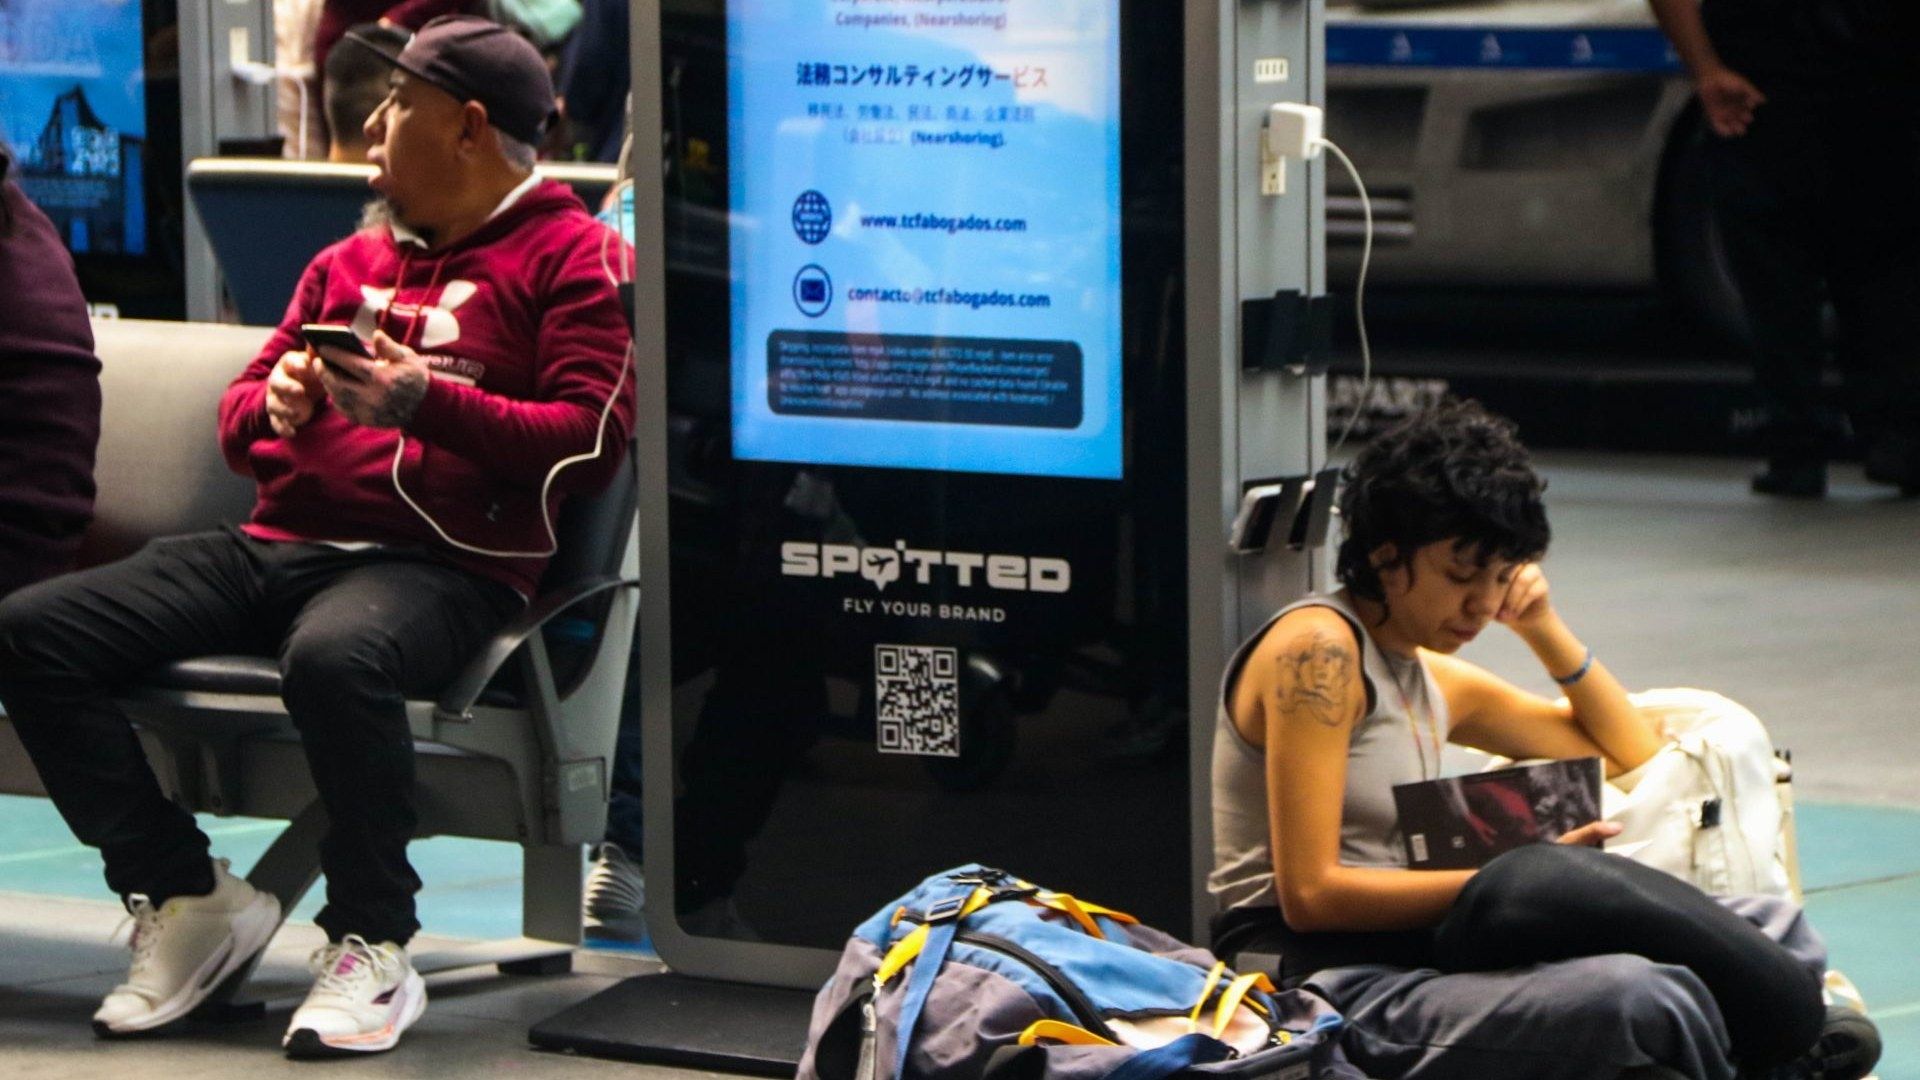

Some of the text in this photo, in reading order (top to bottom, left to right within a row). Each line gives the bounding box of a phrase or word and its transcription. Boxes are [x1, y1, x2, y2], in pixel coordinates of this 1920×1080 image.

[860, 213, 1027, 234] www.tcfabogados.com
[847, 286, 1051, 310] contacto@tcfabogados.com
[843, 598, 1007, 623] FLY YOUR BRAND
